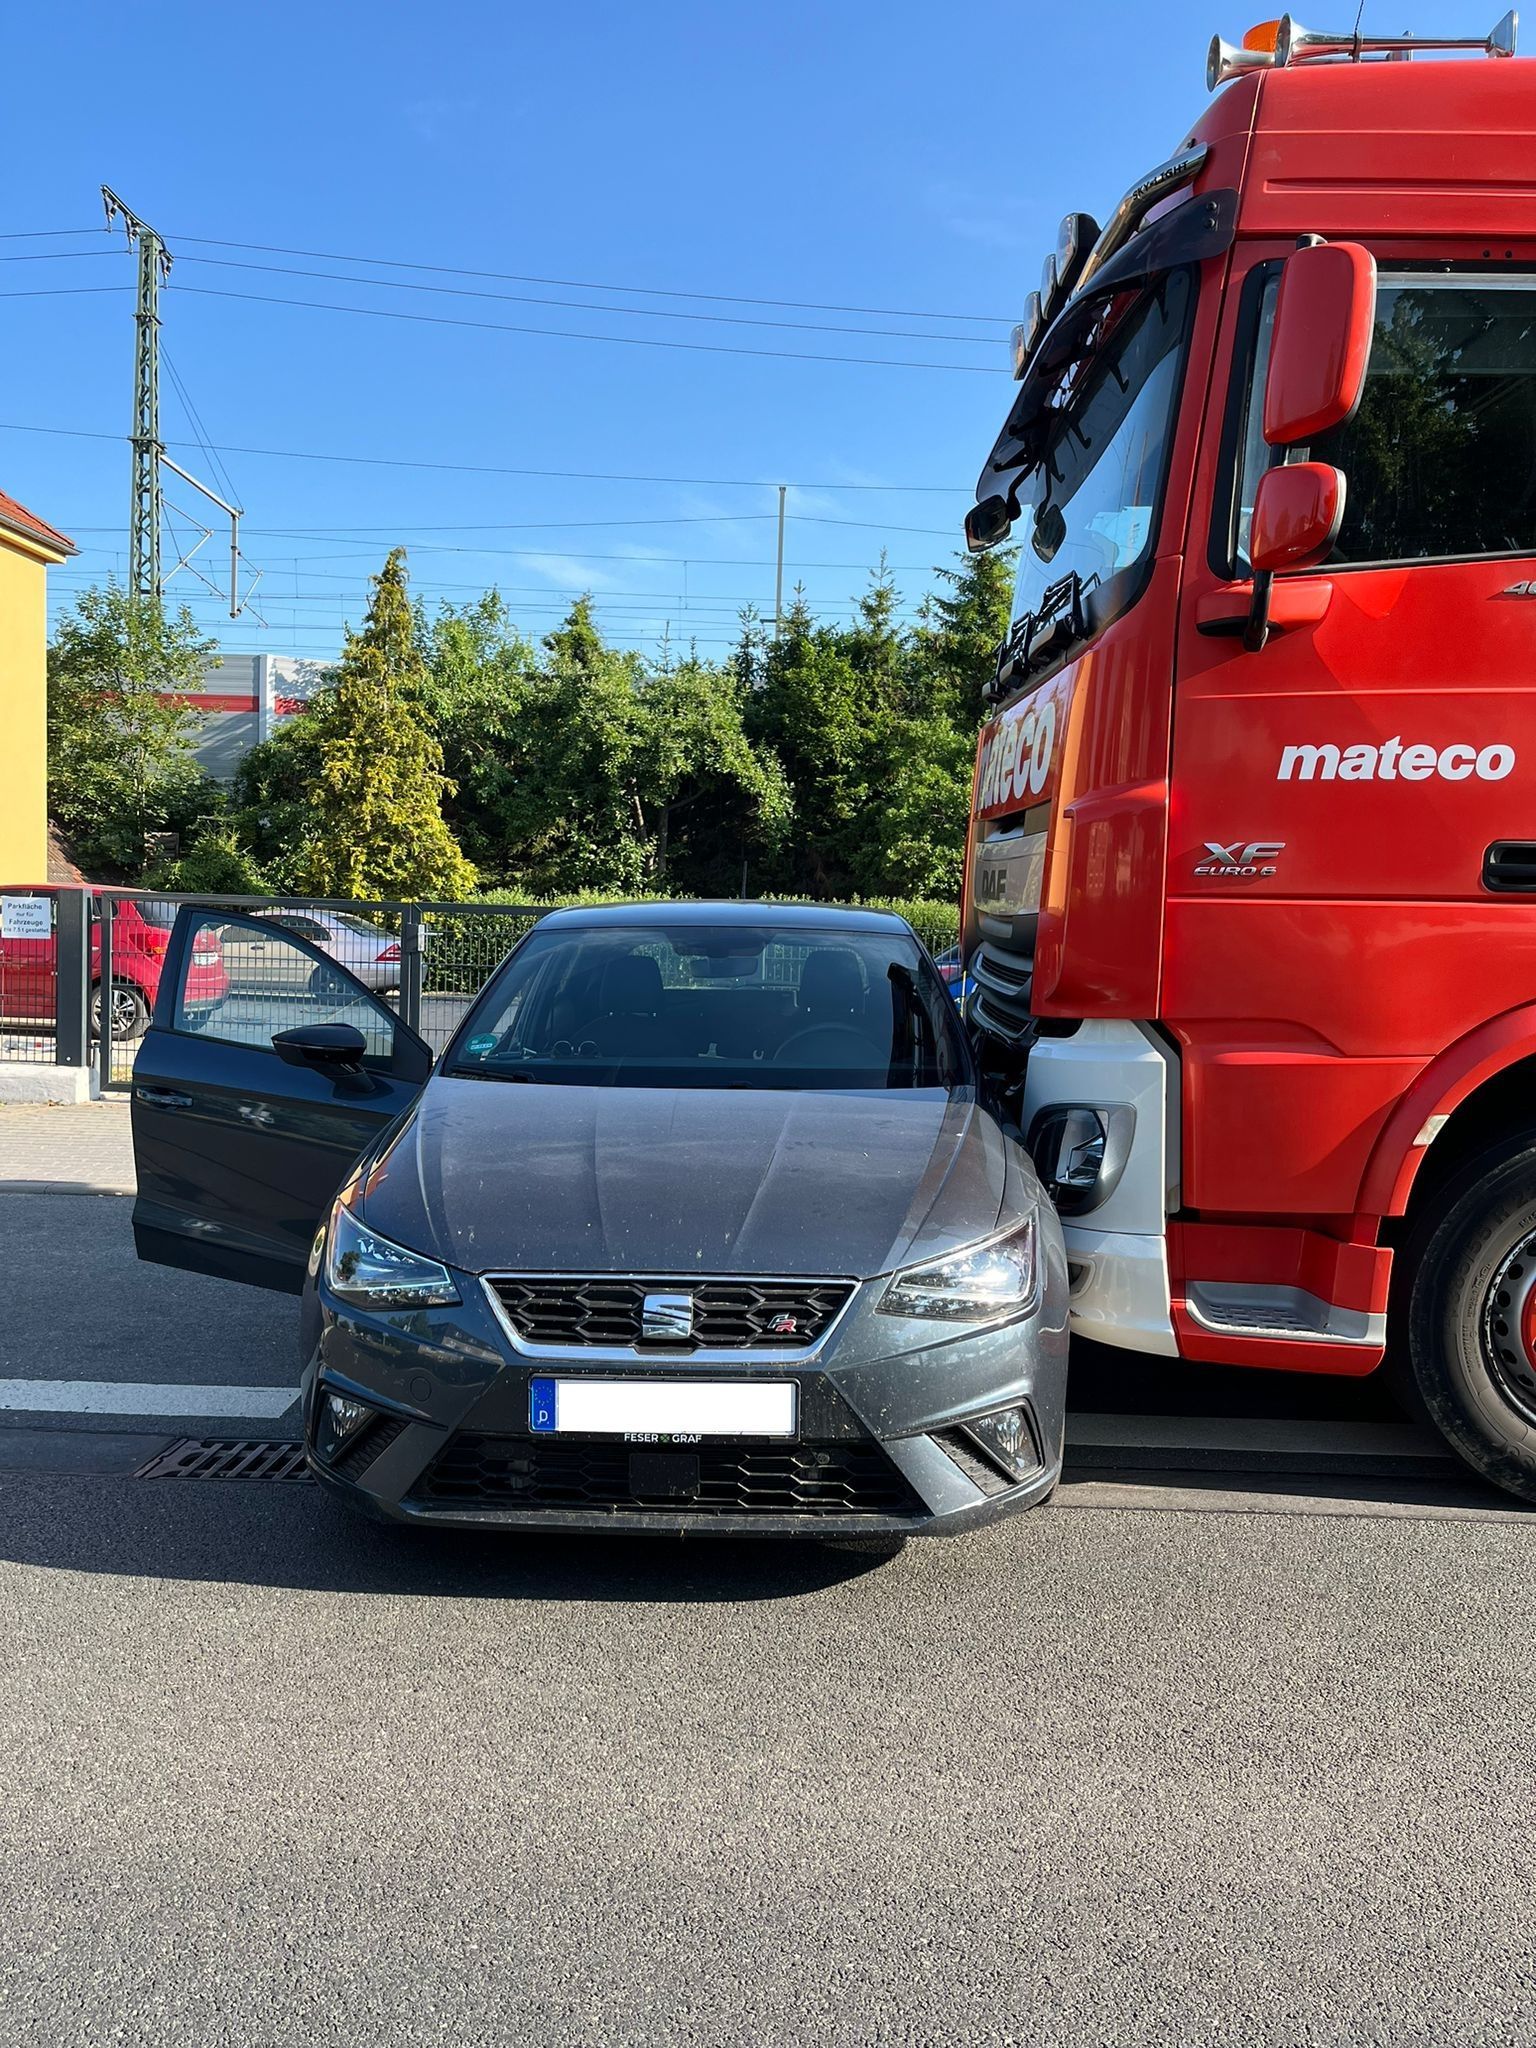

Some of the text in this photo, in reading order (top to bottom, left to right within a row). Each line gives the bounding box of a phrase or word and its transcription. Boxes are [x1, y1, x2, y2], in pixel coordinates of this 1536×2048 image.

[1132, 160, 1189, 200] SKY-LIGHT
[1276, 735, 1516, 780] mateco
[1197, 841, 1286, 864] XF
[1193, 866, 1277, 876] EURO 6
[981, 869, 1007, 900] DAF
[7, 902, 43, 910] Parkfläche
[8, 918, 44, 927] Fahrzeuge
[624, 1433, 702, 1444] FESER GRAF
